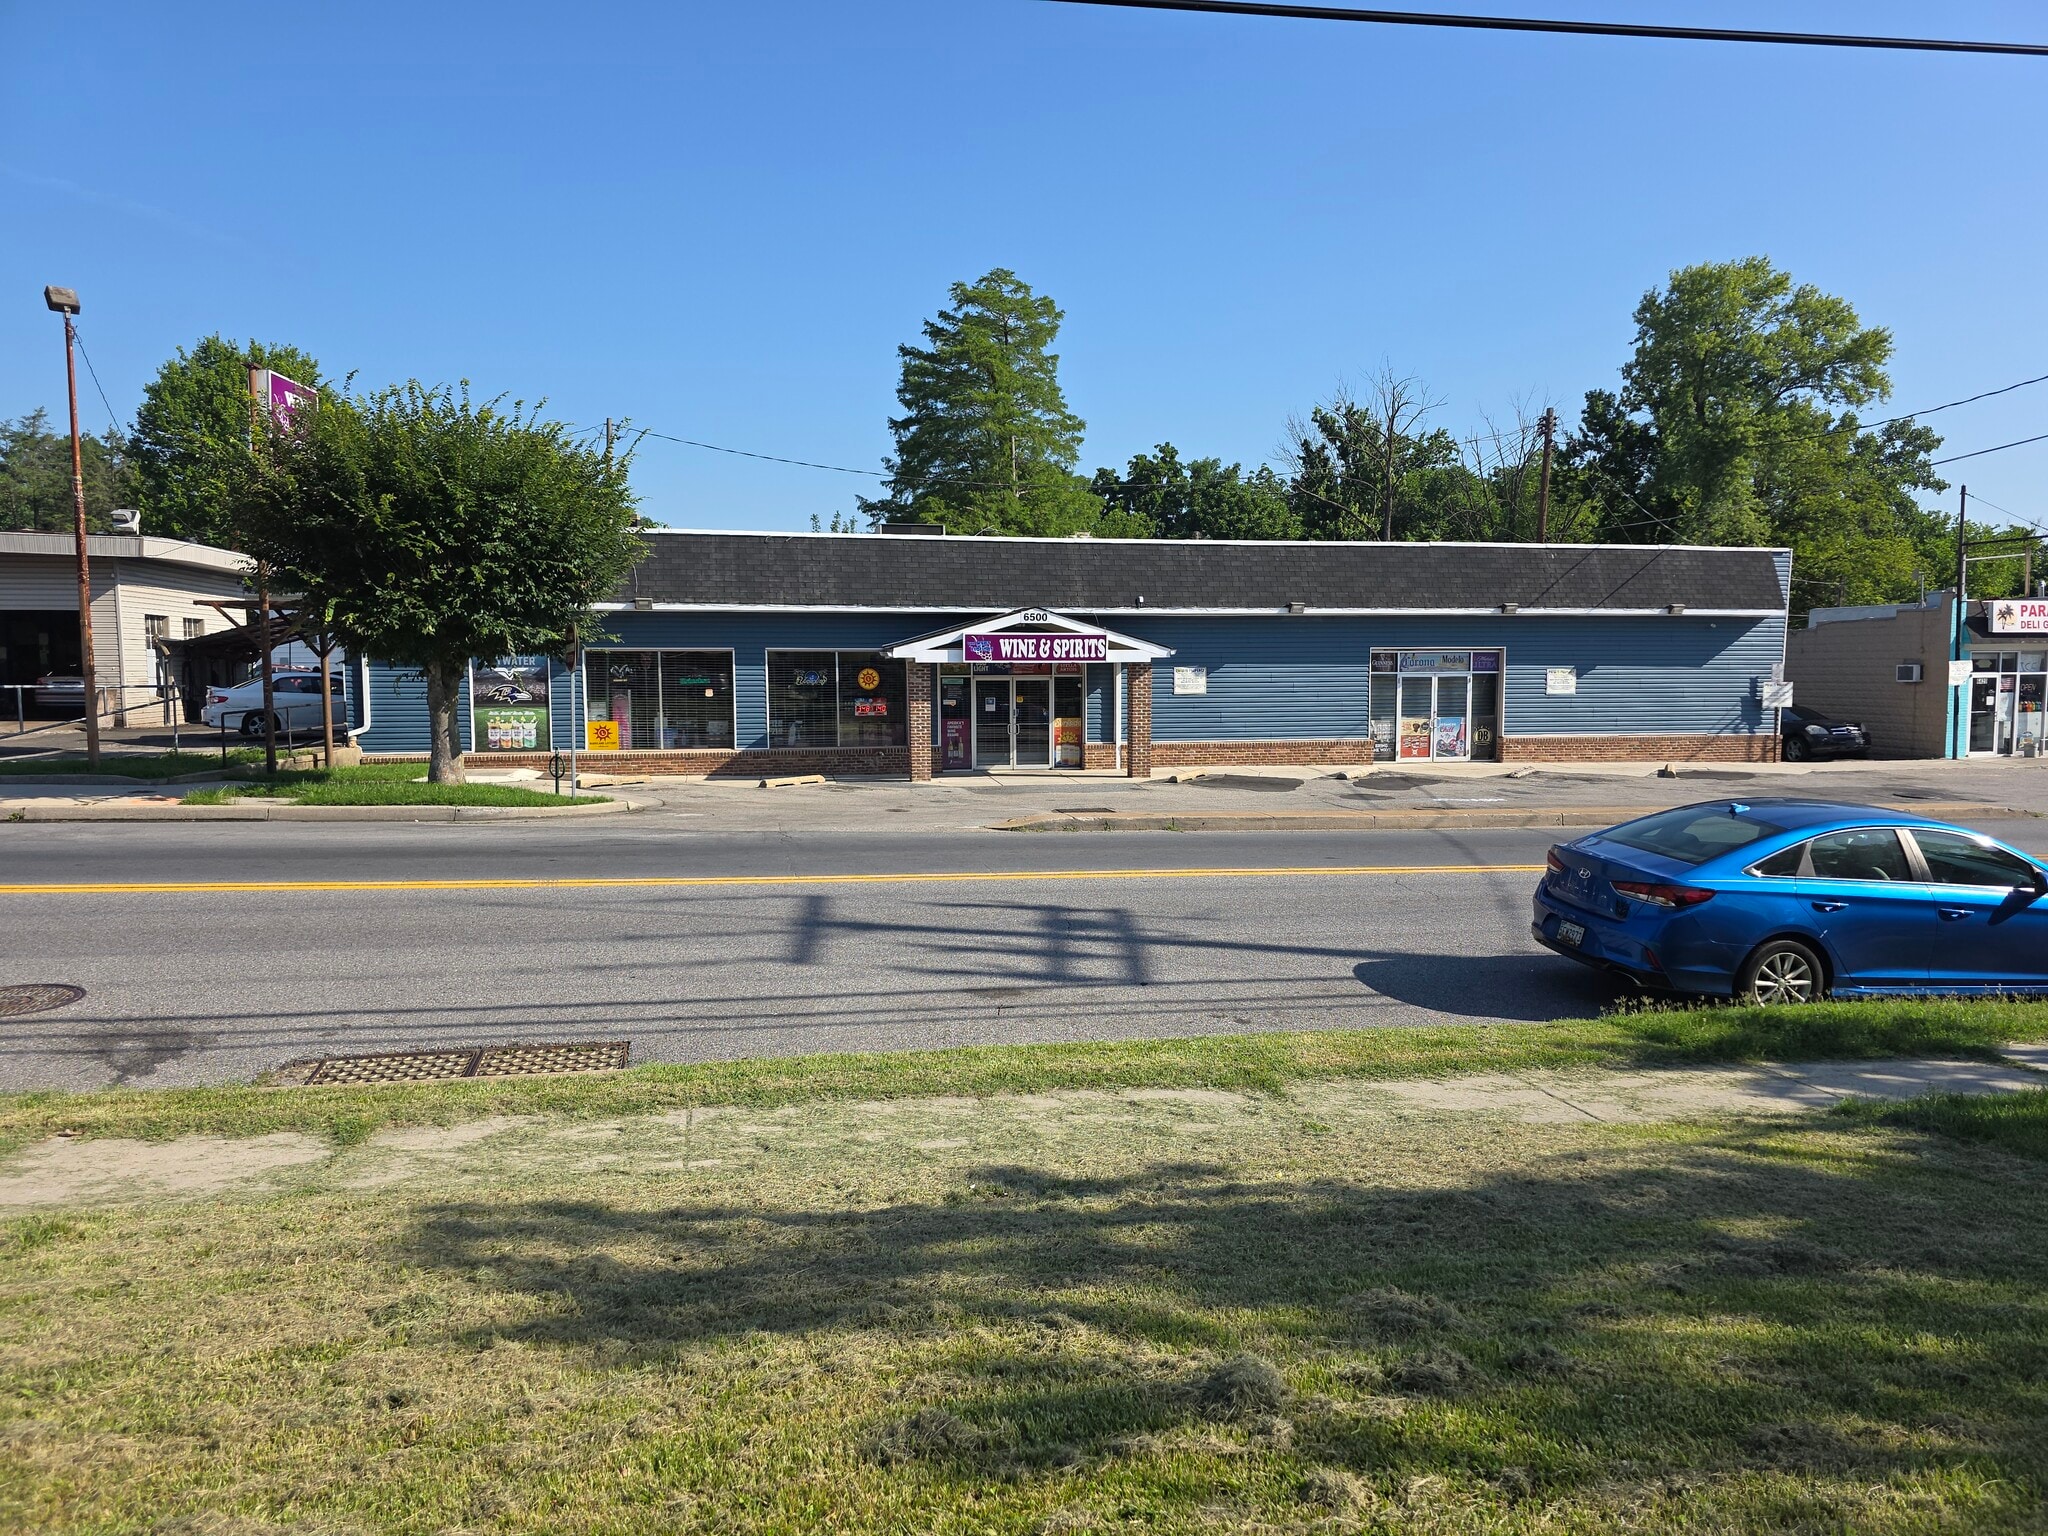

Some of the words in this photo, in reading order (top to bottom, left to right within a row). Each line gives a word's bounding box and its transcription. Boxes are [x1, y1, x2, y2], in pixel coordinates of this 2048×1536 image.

[1023, 612, 1048, 621] 6500
[2020, 604, 2048, 617] PAR
[2020, 620, 2040, 629] DELI
[1000, 639, 1037, 658] WINE
[1039, 638, 1051, 658] &
[1053, 638, 1106, 658] SPIRITS
[1400, 655, 1435, 670] Corona
[1441, 655, 1465, 664] Modelo
